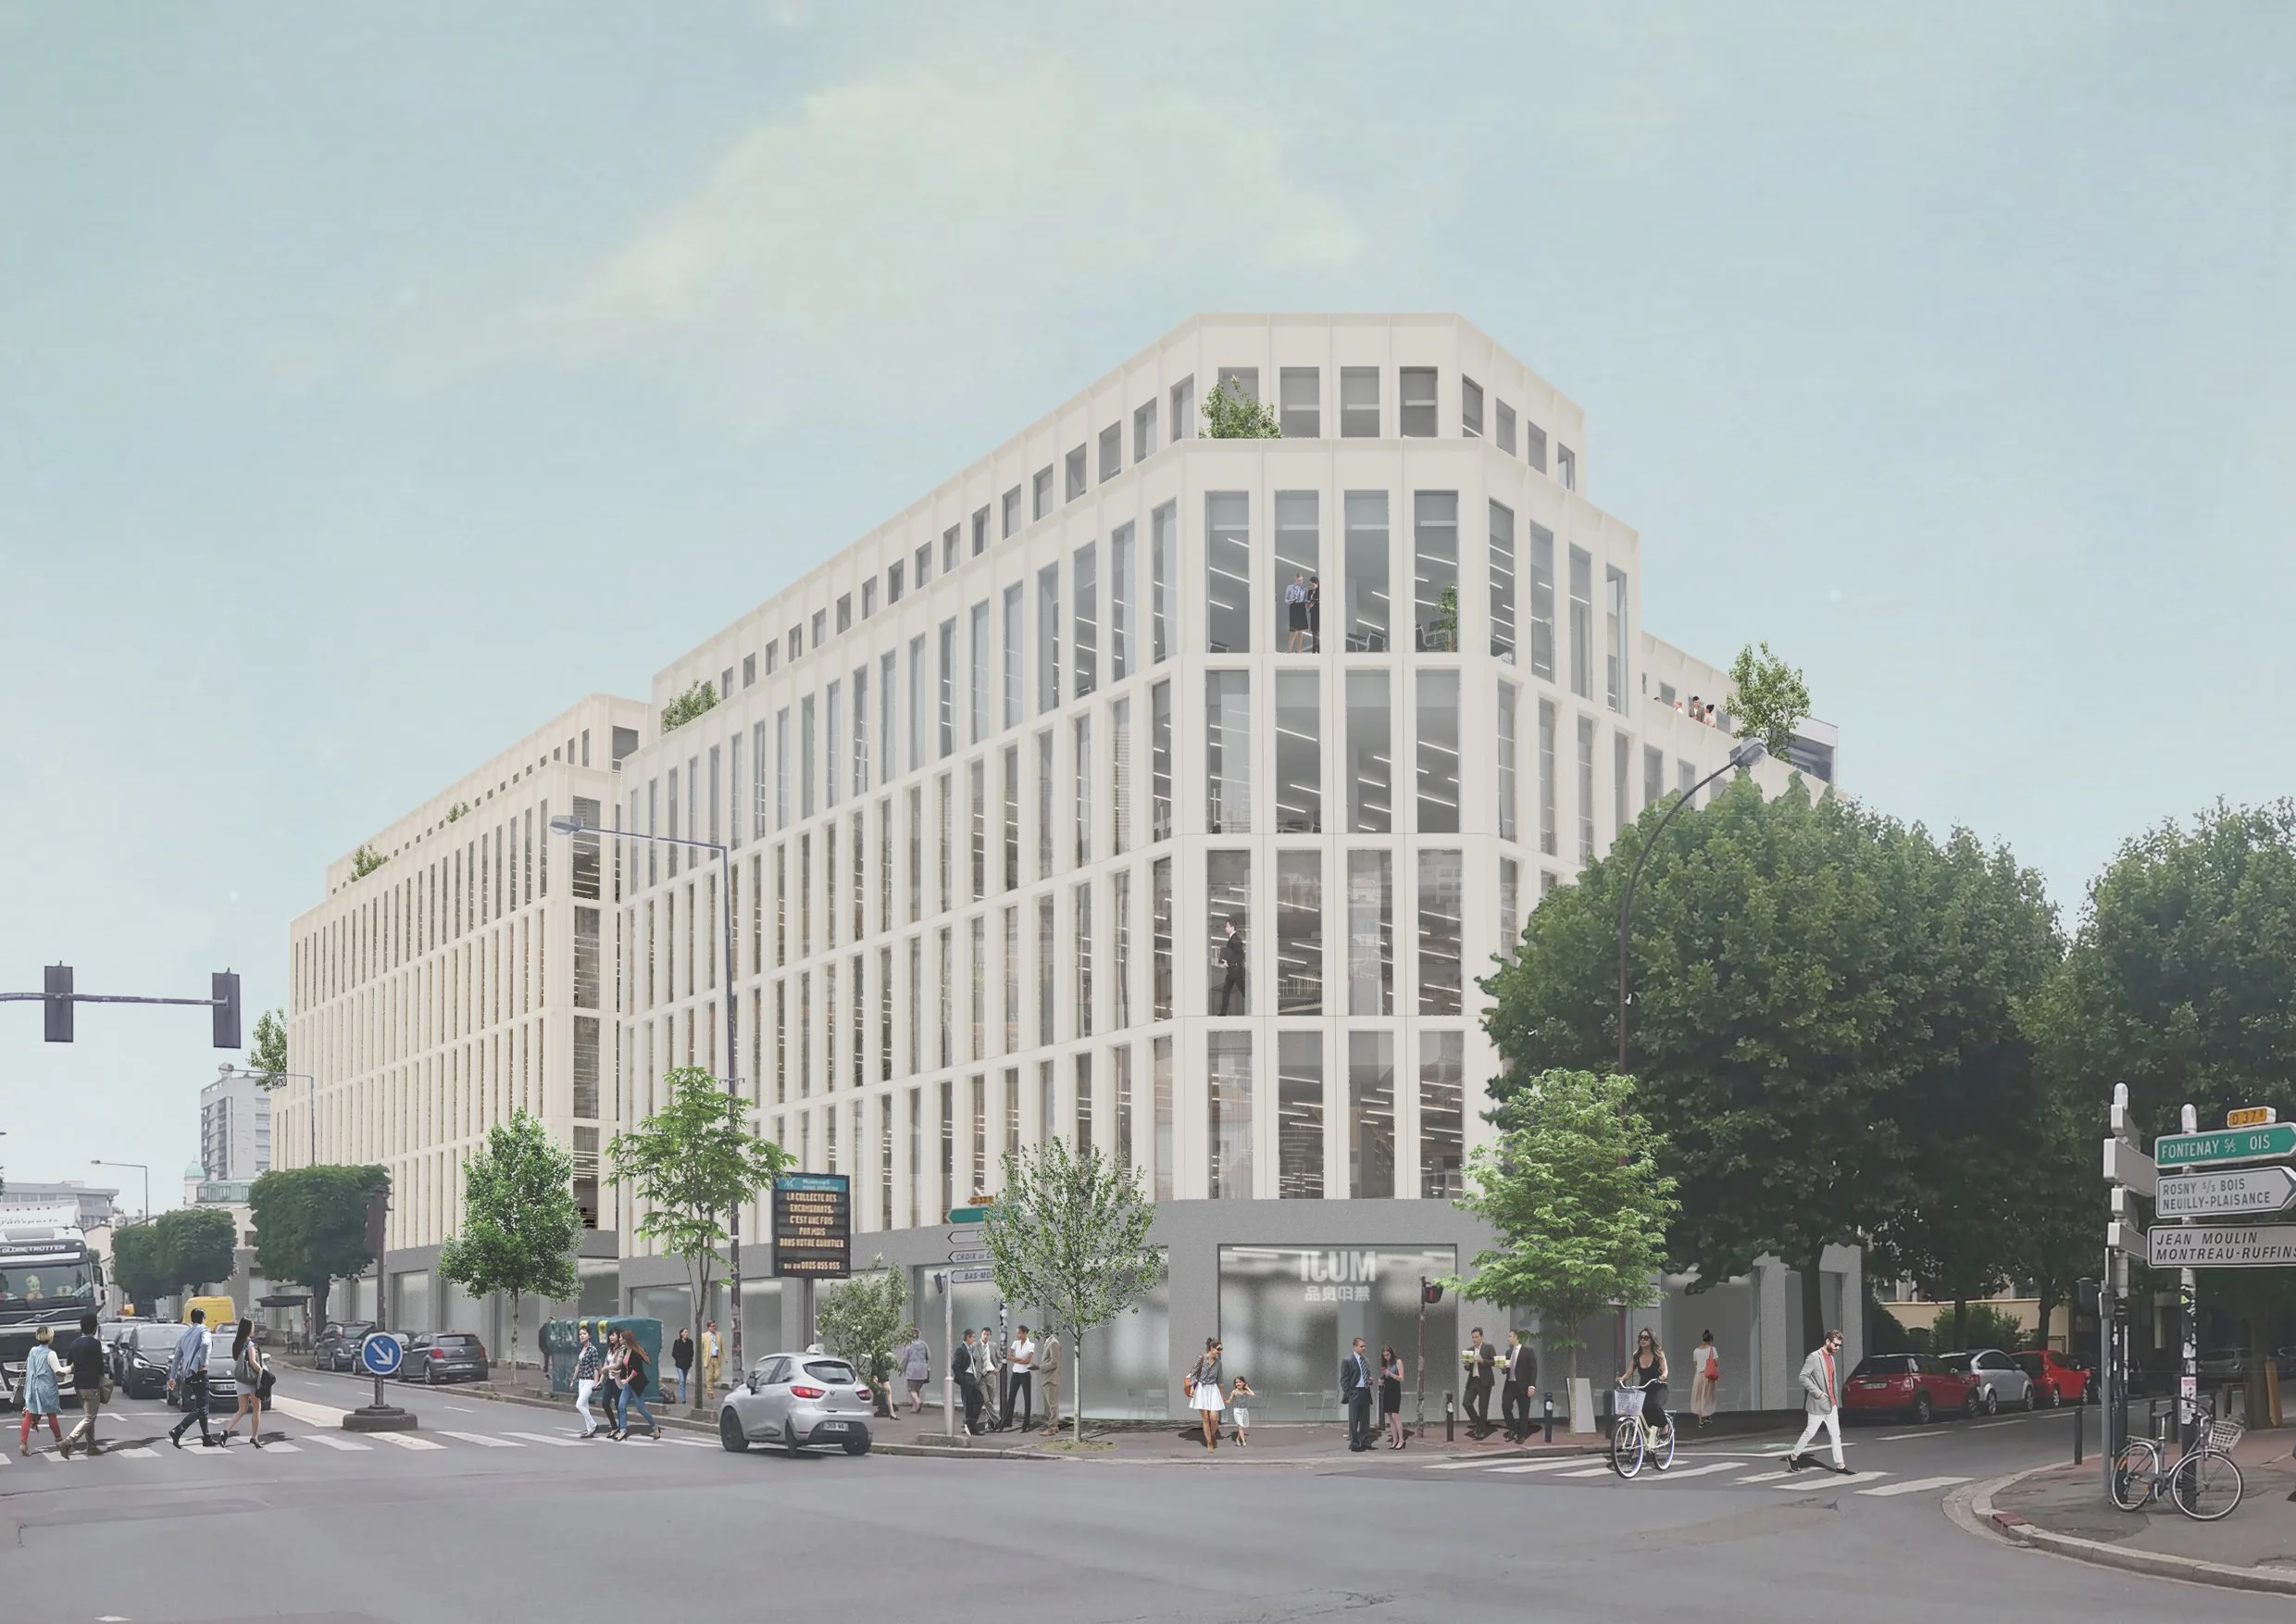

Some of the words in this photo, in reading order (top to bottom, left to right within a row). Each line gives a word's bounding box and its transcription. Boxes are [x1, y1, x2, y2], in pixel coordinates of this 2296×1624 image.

[2161, 1139, 2220, 1159] FONTENAY
[2163, 1181, 2197, 1195] ROSNY
[2220, 1178, 2246, 1191] BOIS
[2163, 1192, 2271, 1210] NEUILLY-PLAISANCE
[2156, 1232, 2192, 1245] JEAN
[2202, 1231, 2258, 1244] MOULIN
[1, 1244, 67, 1254] GLOBETROTTER
[956, 1253, 977, 1261] CROIX
